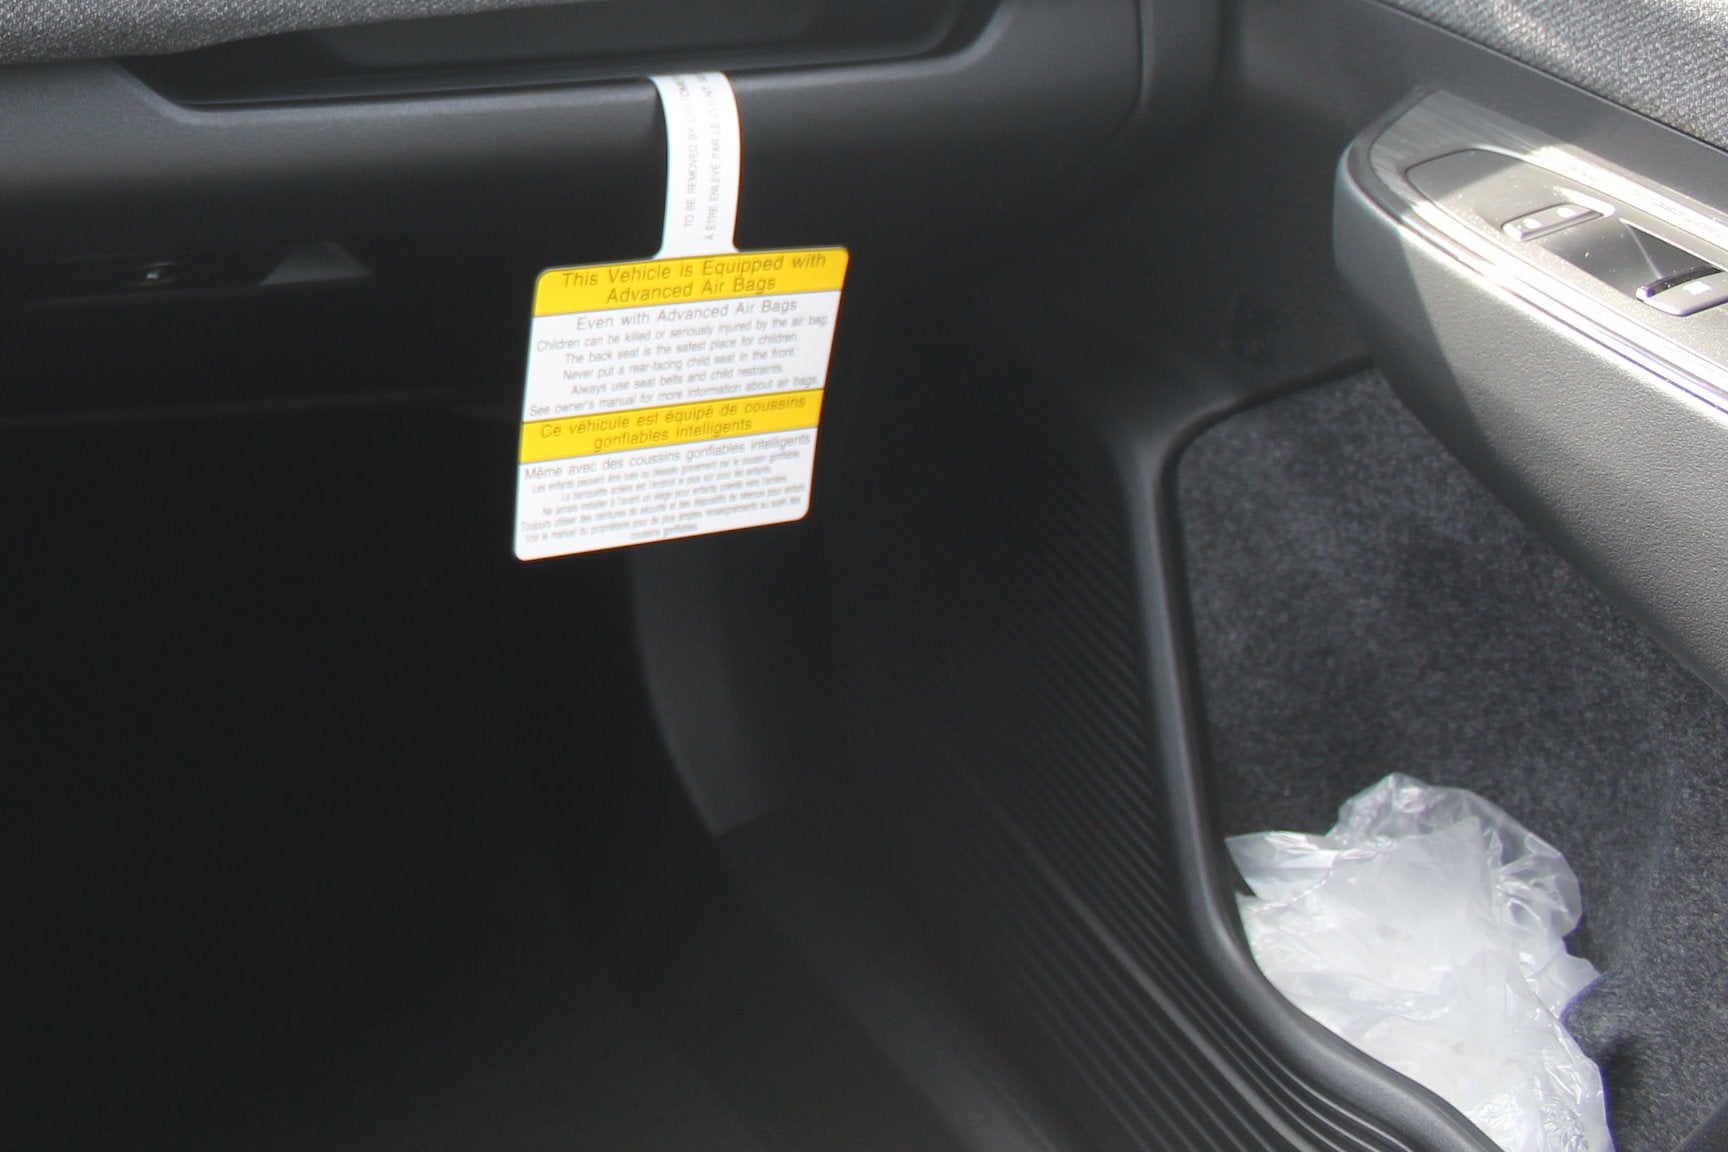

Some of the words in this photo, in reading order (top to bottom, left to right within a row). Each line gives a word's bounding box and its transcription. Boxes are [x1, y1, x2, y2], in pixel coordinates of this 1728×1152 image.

[562, 272, 599, 288] This
[609, 265, 671, 284] Vehicle
[680, 263, 693, 277] is
[702, 255, 785, 278] Equipped
[792, 253, 826, 269] with
[606, 282, 693, 304] Advanced
[701, 280, 725, 295] Air
[733, 278, 776, 296] Bags
[577, 317, 613, 331] Even
[621, 312, 650, 326] with
[657, 305, 729, 322] Advanced
[735, 302, 754, 315] Air
[761, 300, 797, 315] Bags
[536, 338, 580, 352] Children
[584, 336, 603, 347] can
[608, 334, 620, 345] be
[541, 424, 561, 439] Ce
[569, 416, 630, 435] véhicule
[637, 413, 659, 426] est
[665, 404, 714, 424] équipé
[720, 404, 738, 417] de
[744, 396, 806, 414] coussins
[593, 429, 669, 453] gonflables
[676, 419, 752, 438] intelligents
[525, 467, 562, 480] Même
[568, 462, 597, 475] avec
[603, 458, 624, 471] des
[629, 450, 681, 466] coussins
